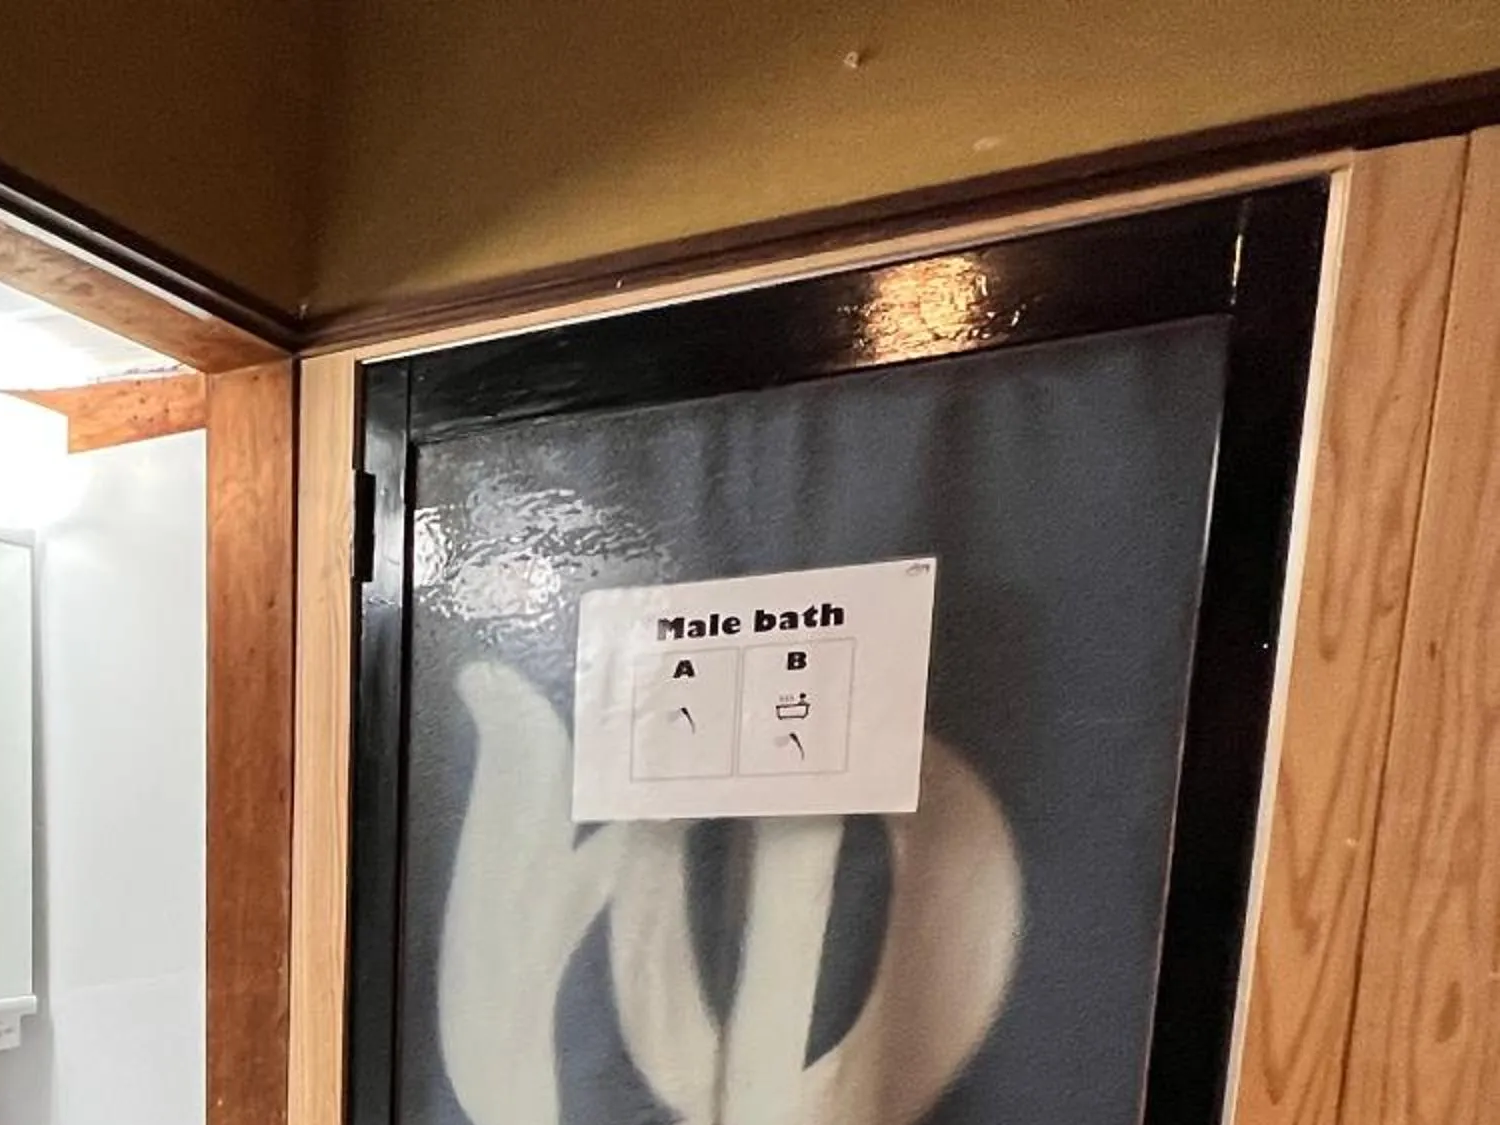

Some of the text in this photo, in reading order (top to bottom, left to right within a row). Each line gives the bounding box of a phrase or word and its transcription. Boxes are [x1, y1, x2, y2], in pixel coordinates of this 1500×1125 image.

[656, 603, 845, 641] Male bath
[672, 659, 697, 679] A
[786, 651, 808, 672] B
